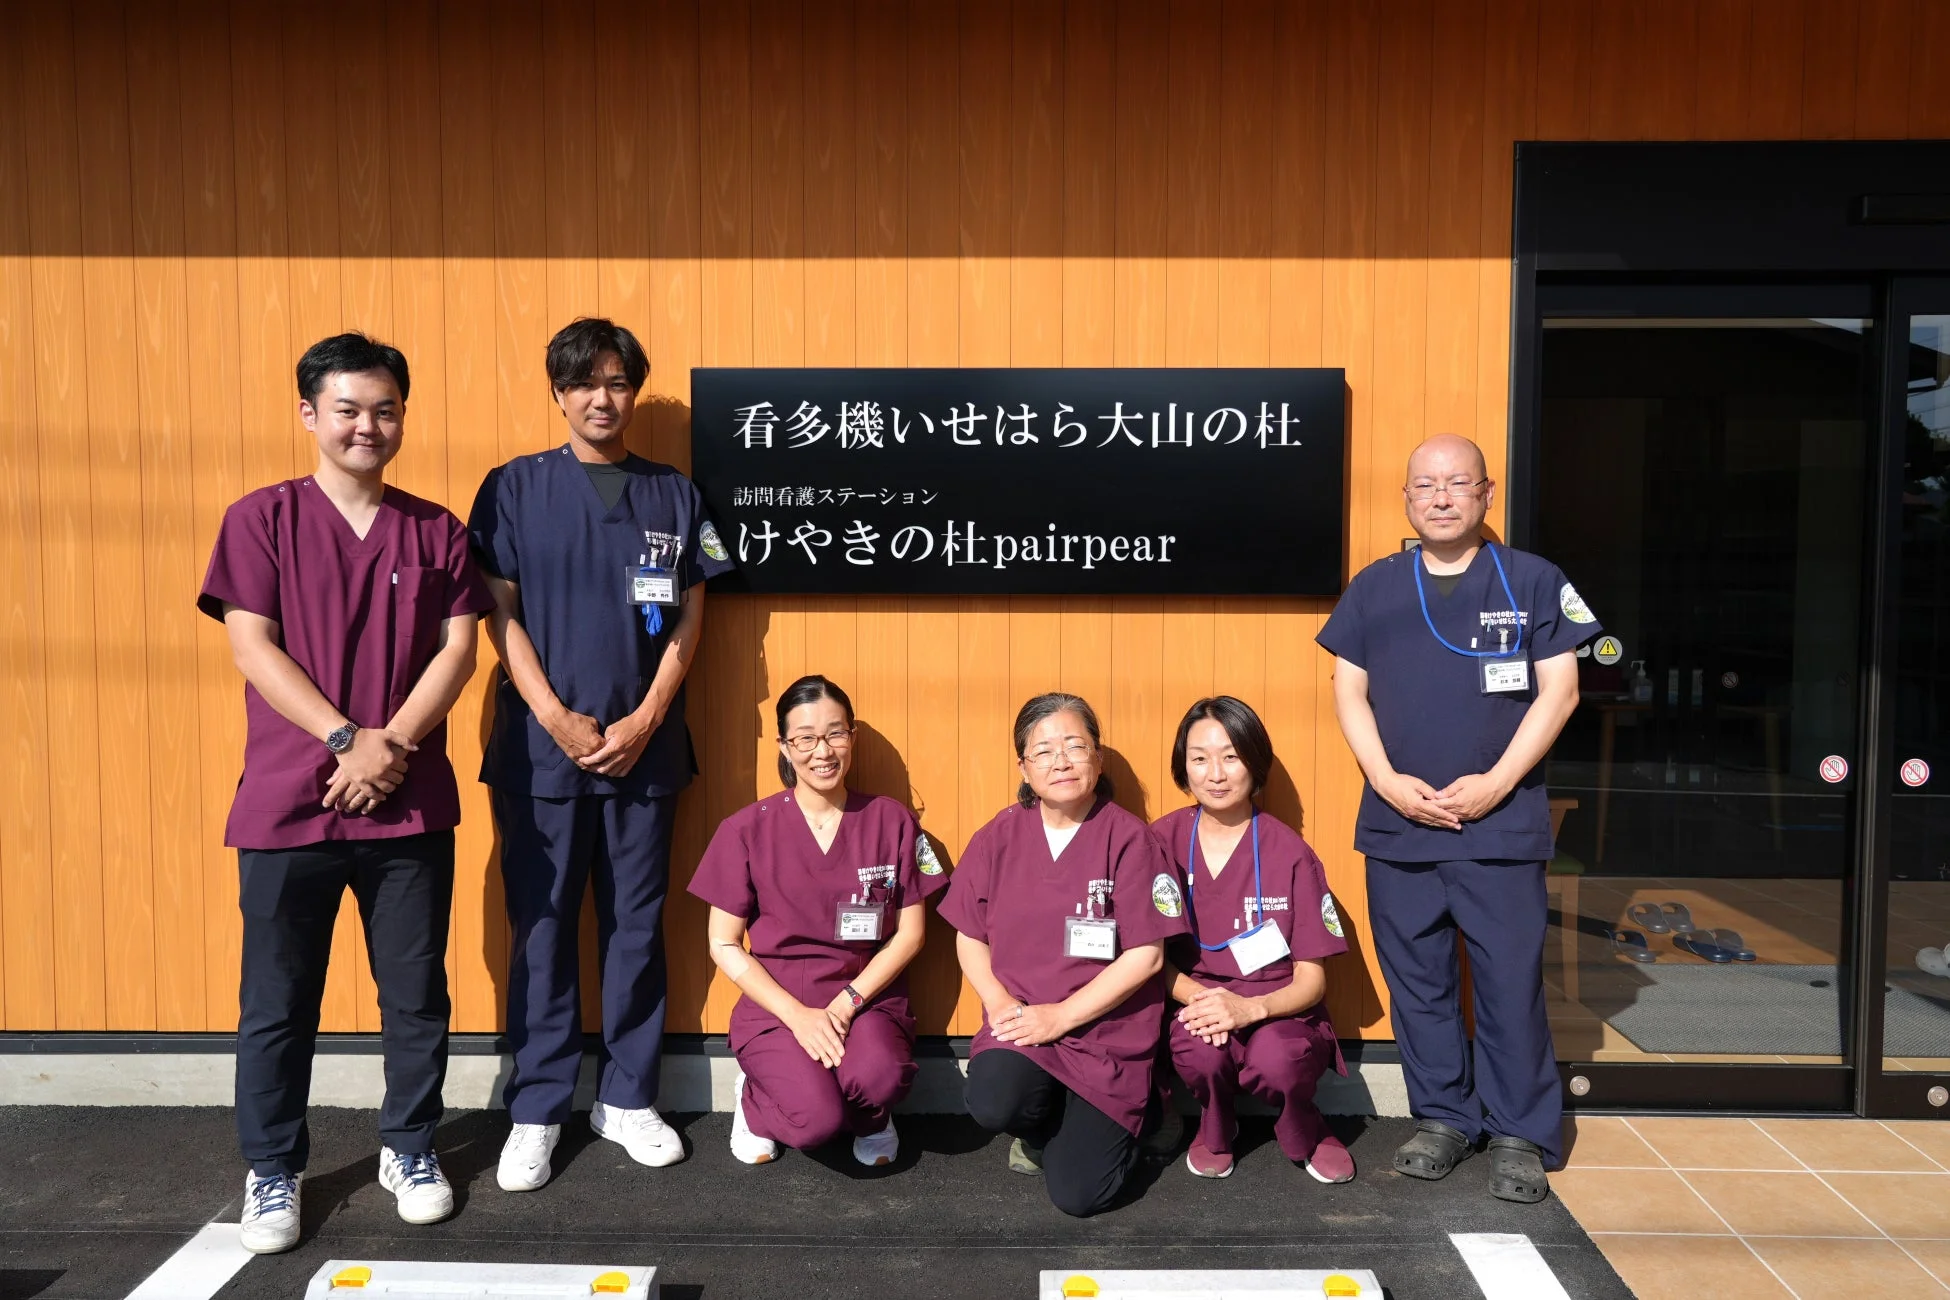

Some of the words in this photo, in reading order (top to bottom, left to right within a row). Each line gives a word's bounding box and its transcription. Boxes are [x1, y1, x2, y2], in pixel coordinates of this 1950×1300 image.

[733, 401, 1302, 449] 看多機いせはら大山の杜
[733, 486, 938, 507] 訪問看護ステーション
[738, 519, 1176, 569] けやきの杜pairpear
